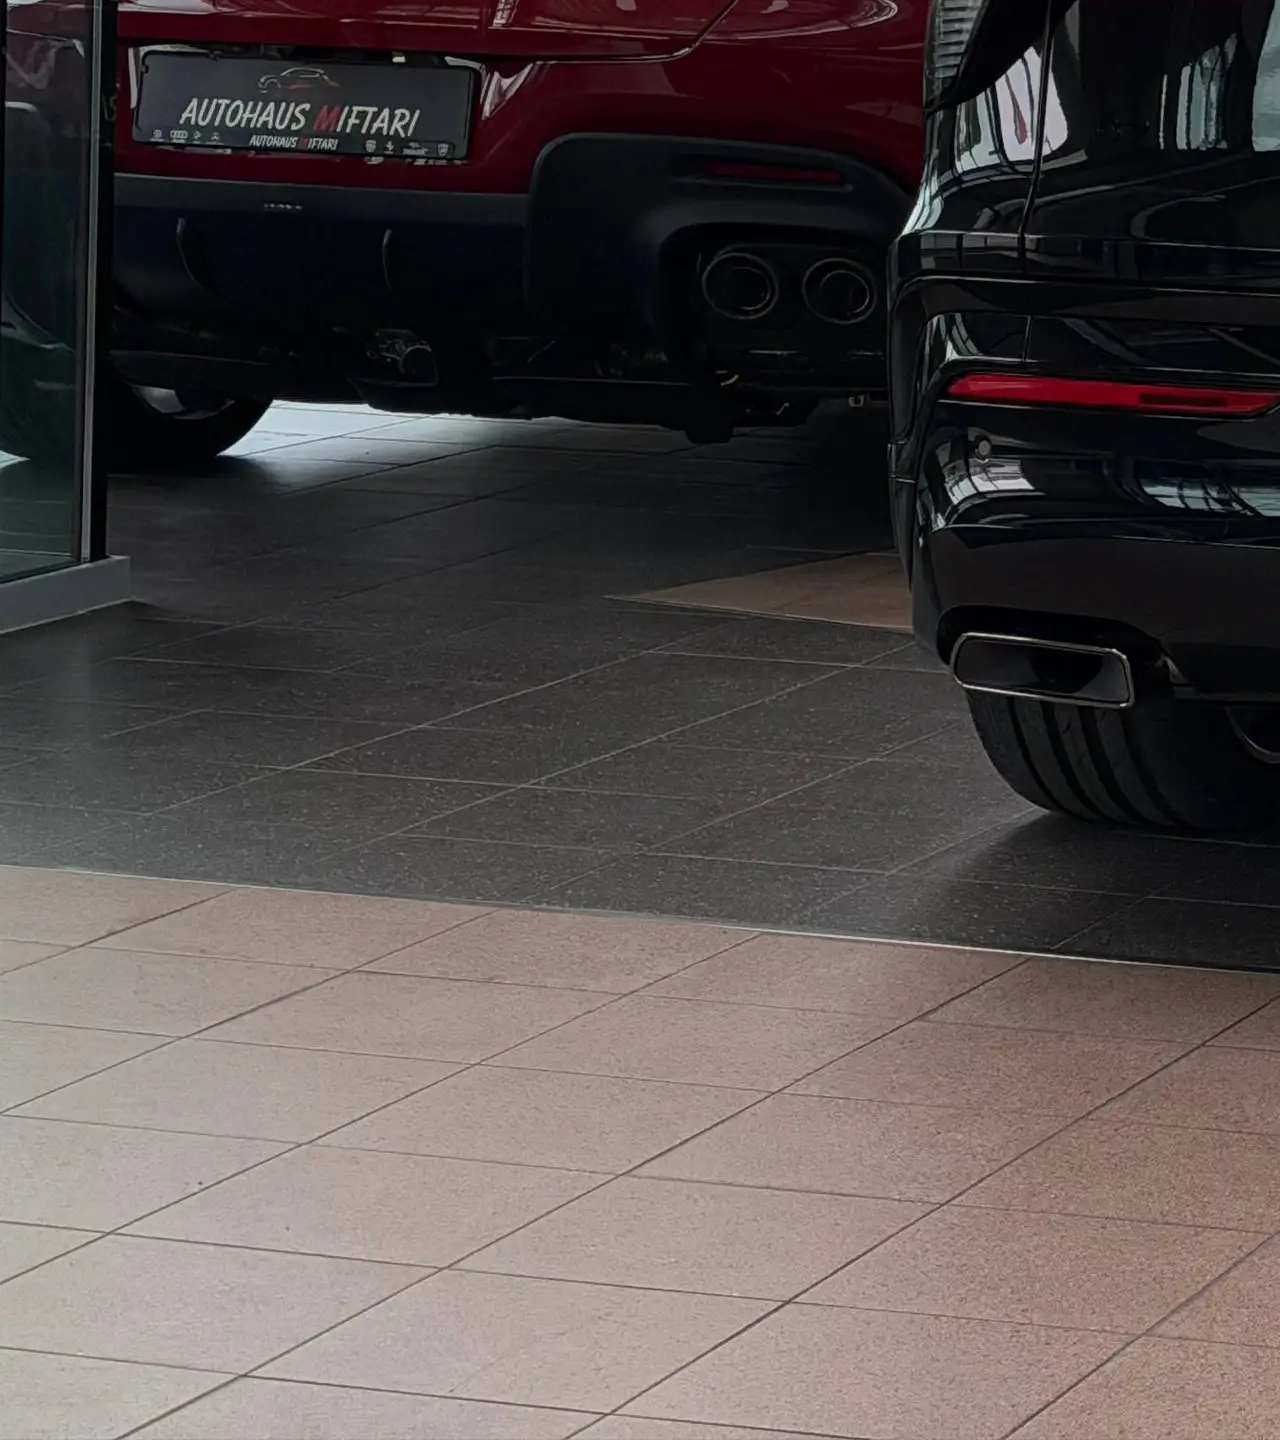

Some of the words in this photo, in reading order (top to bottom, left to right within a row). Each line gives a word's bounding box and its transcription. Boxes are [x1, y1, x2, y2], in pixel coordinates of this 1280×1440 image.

[180, 98, 310, 131] AUTOHAUS
[313, 105, 420, 138] MIFTARI
[249, 135, 298, 148] AUTOHAUS
